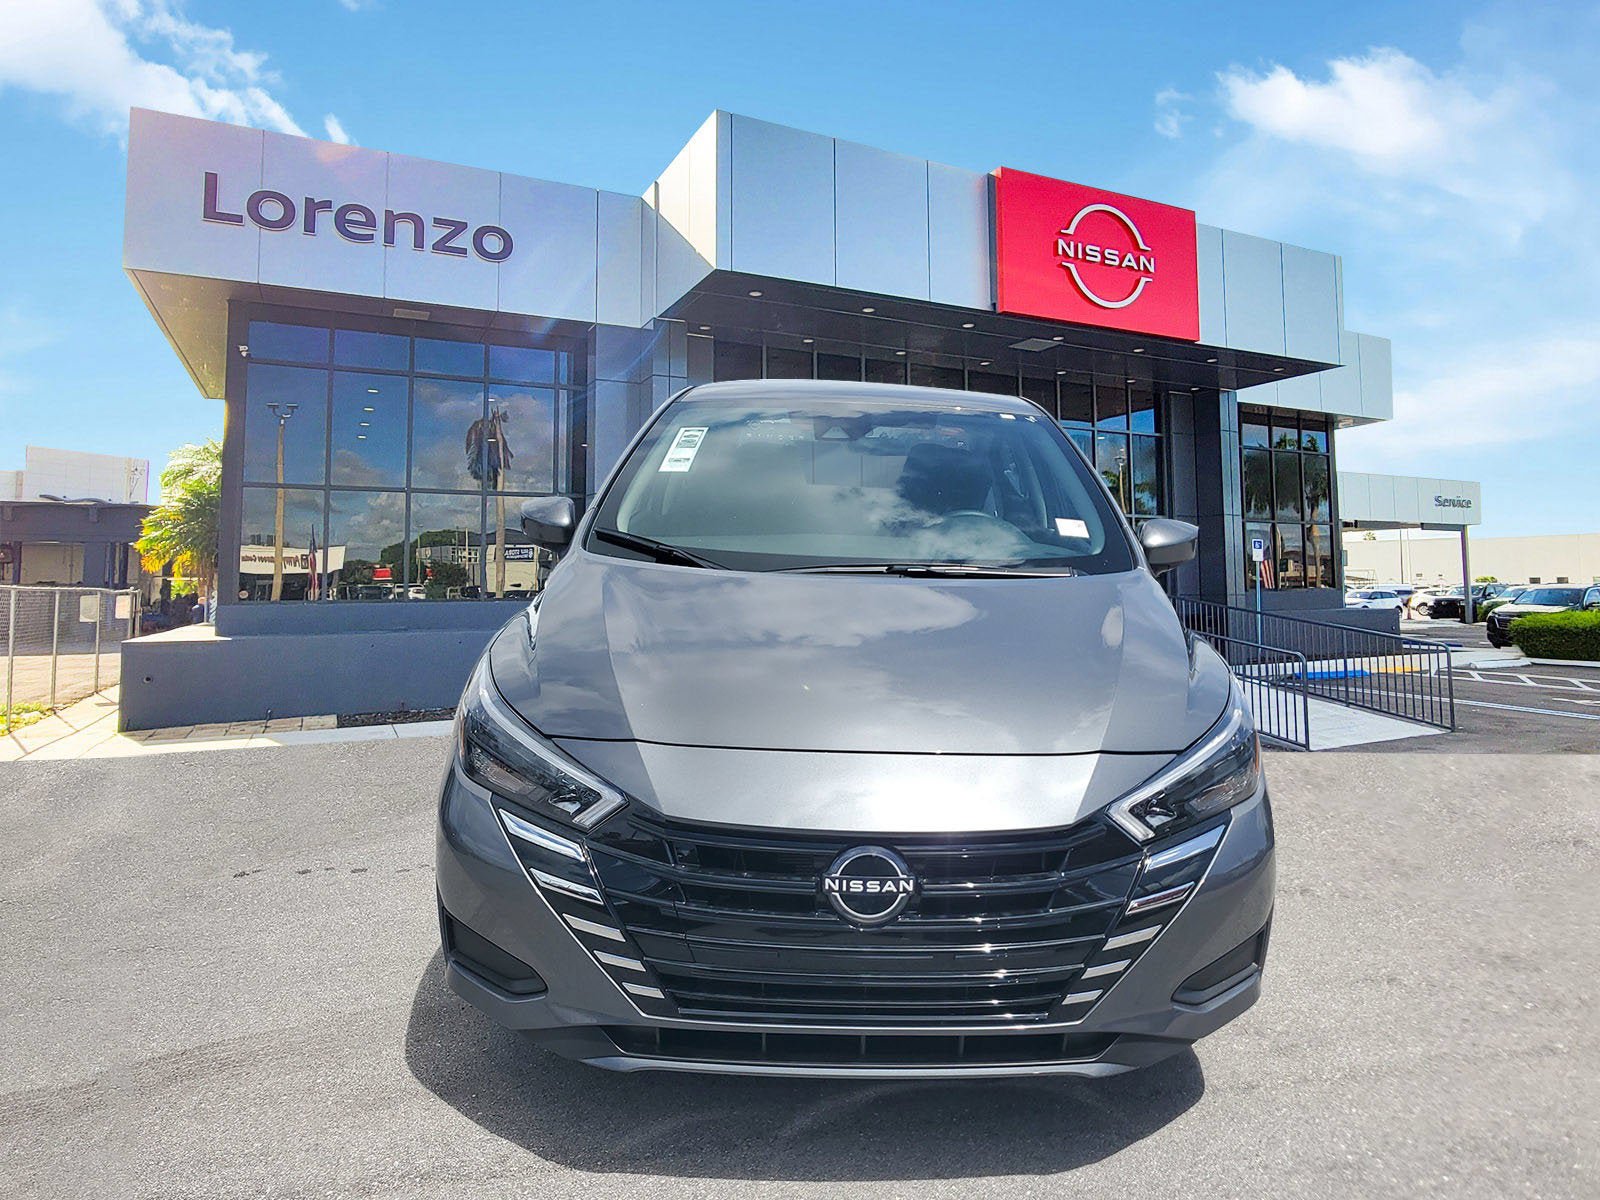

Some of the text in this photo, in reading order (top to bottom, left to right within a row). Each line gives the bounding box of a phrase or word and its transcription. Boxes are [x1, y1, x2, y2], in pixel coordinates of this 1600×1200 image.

[202, 171, 514, 262] Lorenzo
[1057, 238, 1155, 273] NISSAN
[1434, 495, 1472, 508] Service
[825, 878, 914, 893] NISSAN
